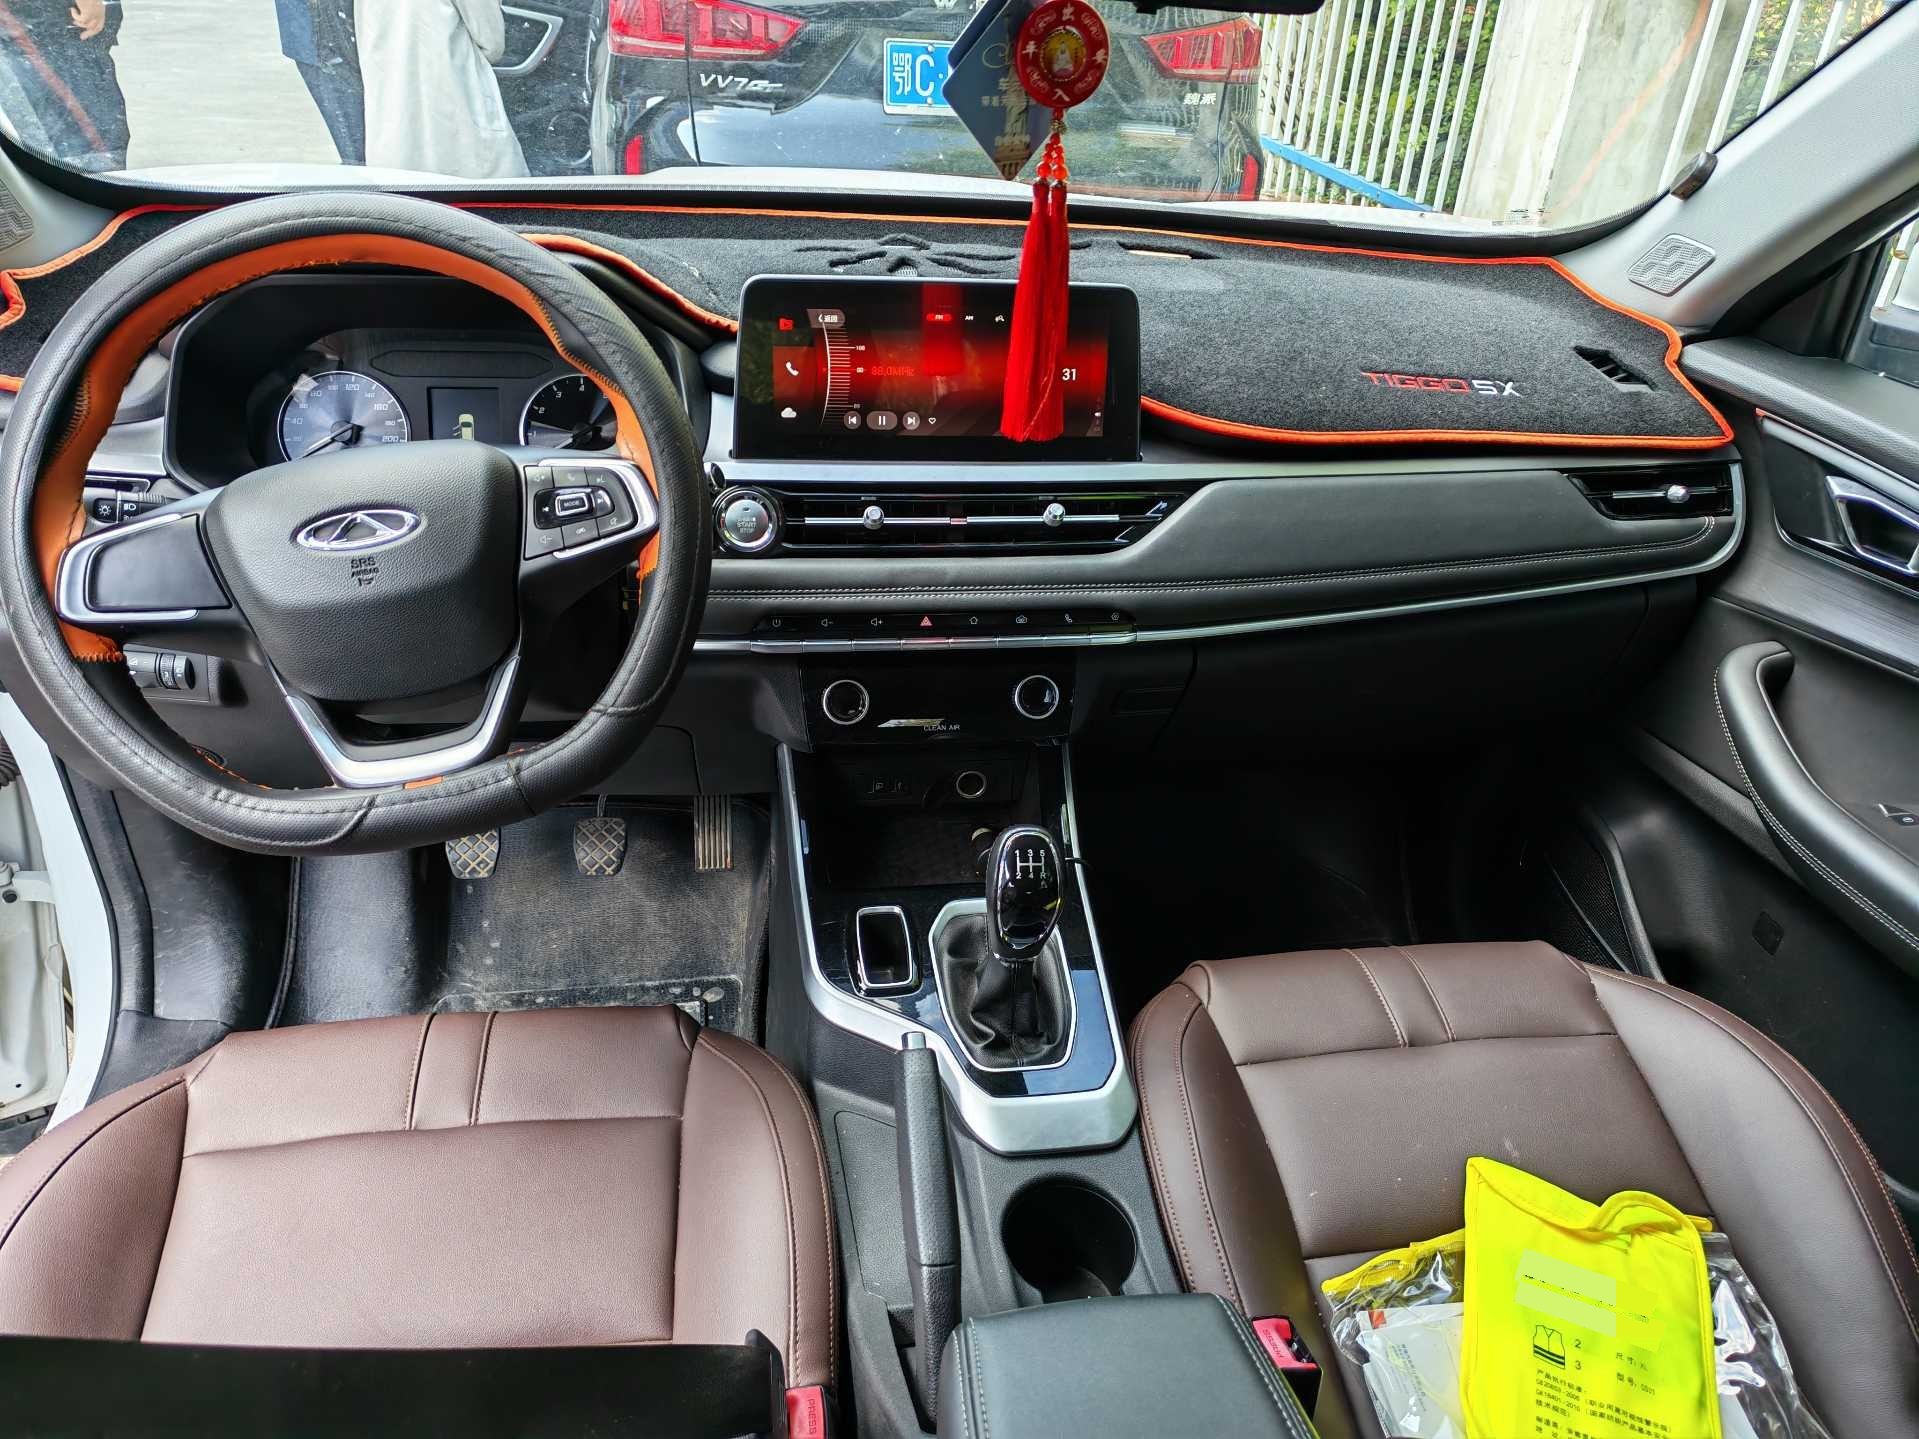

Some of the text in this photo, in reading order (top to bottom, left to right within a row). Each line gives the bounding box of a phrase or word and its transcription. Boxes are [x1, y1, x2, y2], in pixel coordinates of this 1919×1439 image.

[1062, 368, 1077, 381] 31
[1574, 1339, 1582, 1348] 2
[1575, 1361, 1582, 1370] 3
